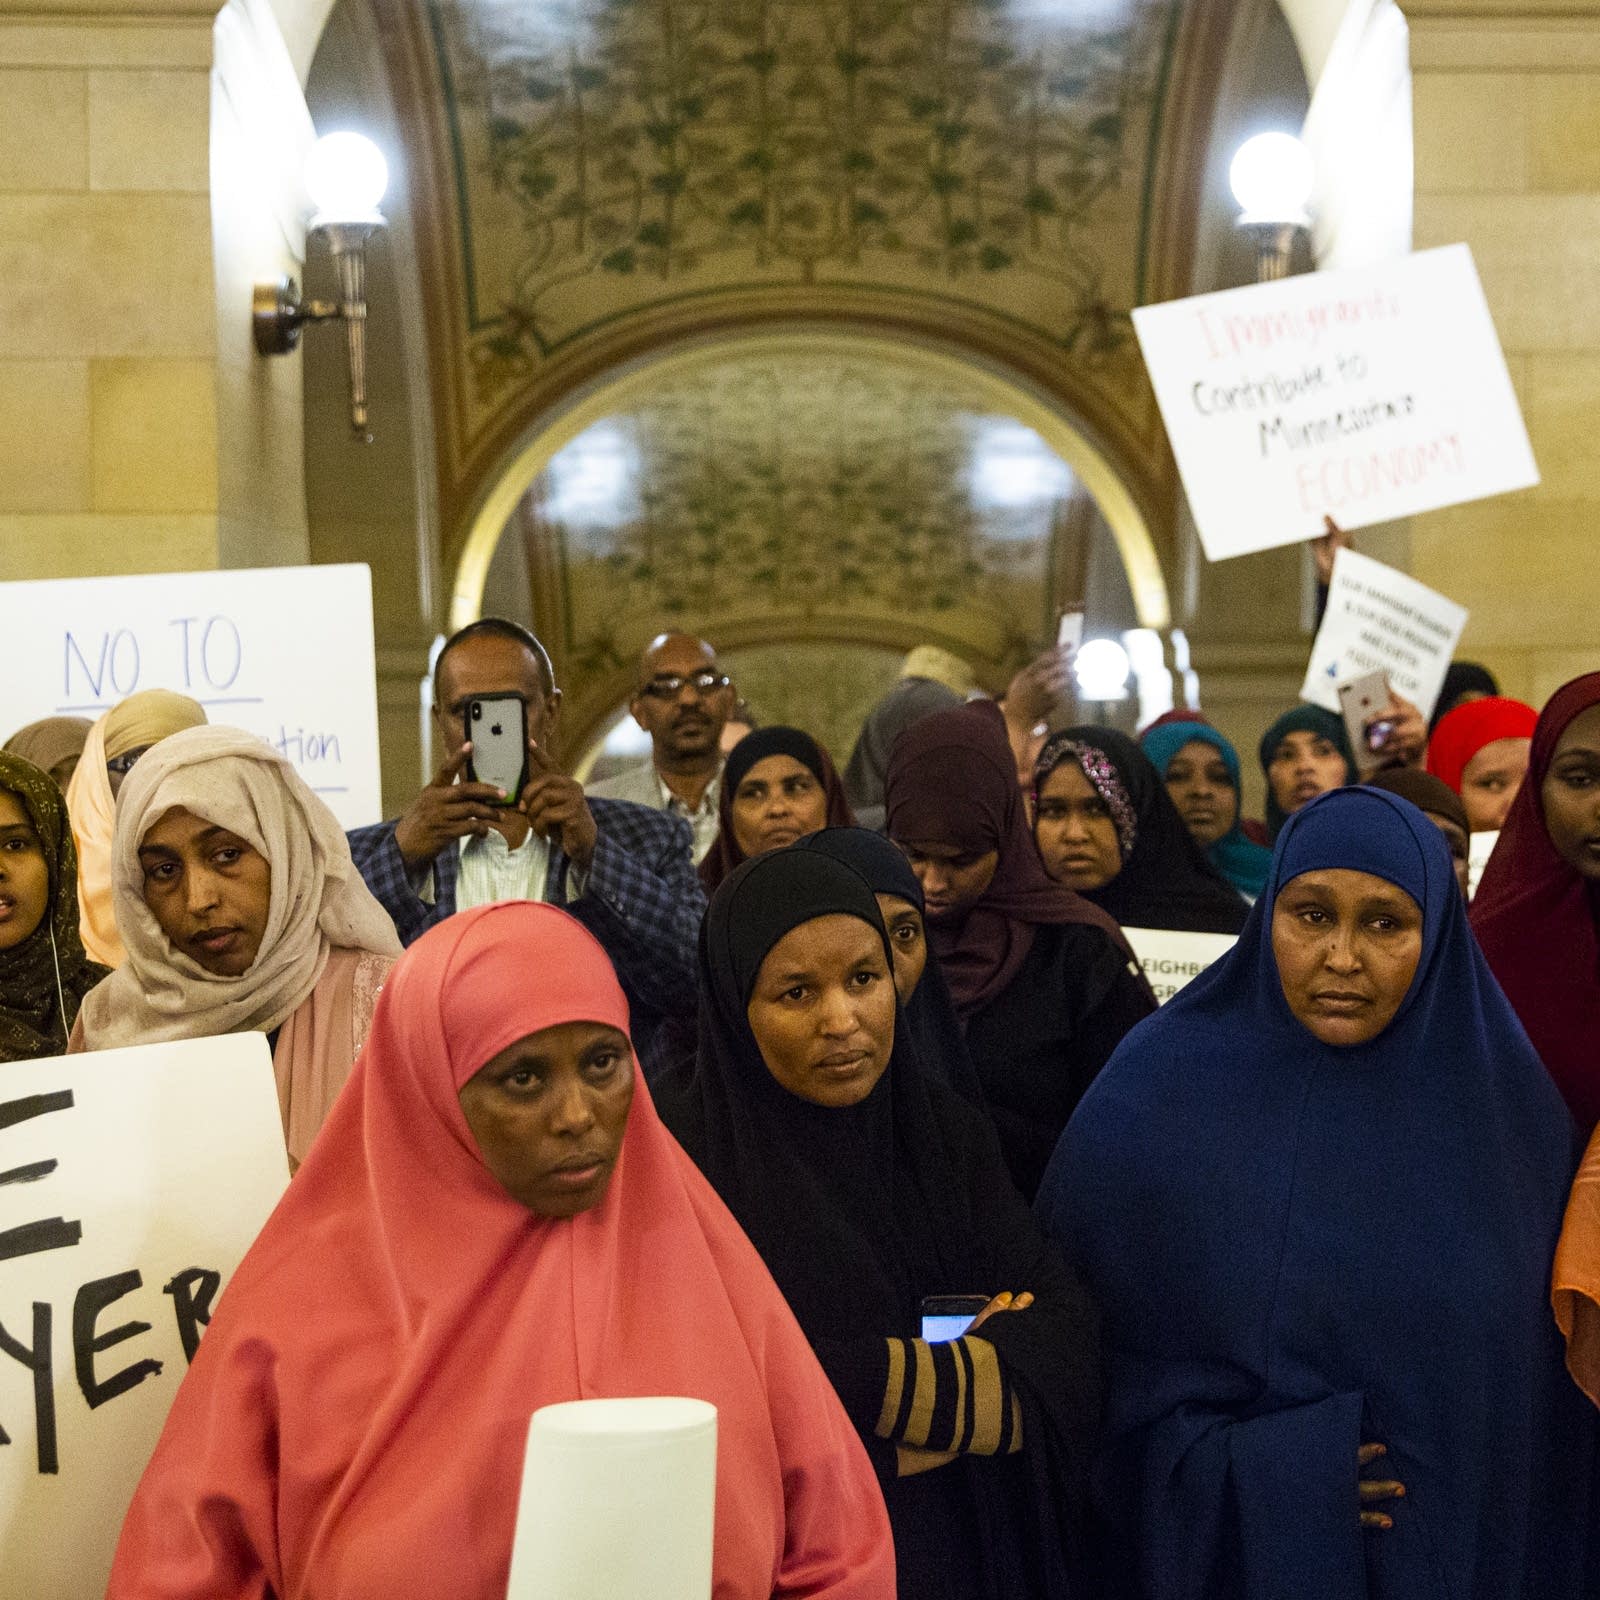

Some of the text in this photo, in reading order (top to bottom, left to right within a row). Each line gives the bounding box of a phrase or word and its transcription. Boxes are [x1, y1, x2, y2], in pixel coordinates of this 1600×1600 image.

[1191, 350, 1368, 416] Contribute to
[1295, 432, 1468, 513] ECONOMY
[63, 614, 242, 697] NO TO
[267, 726, 342, 765] tion
[1140, 957, 1212, 976] EIGHB
[0, 1268, 221, 1475] YER
